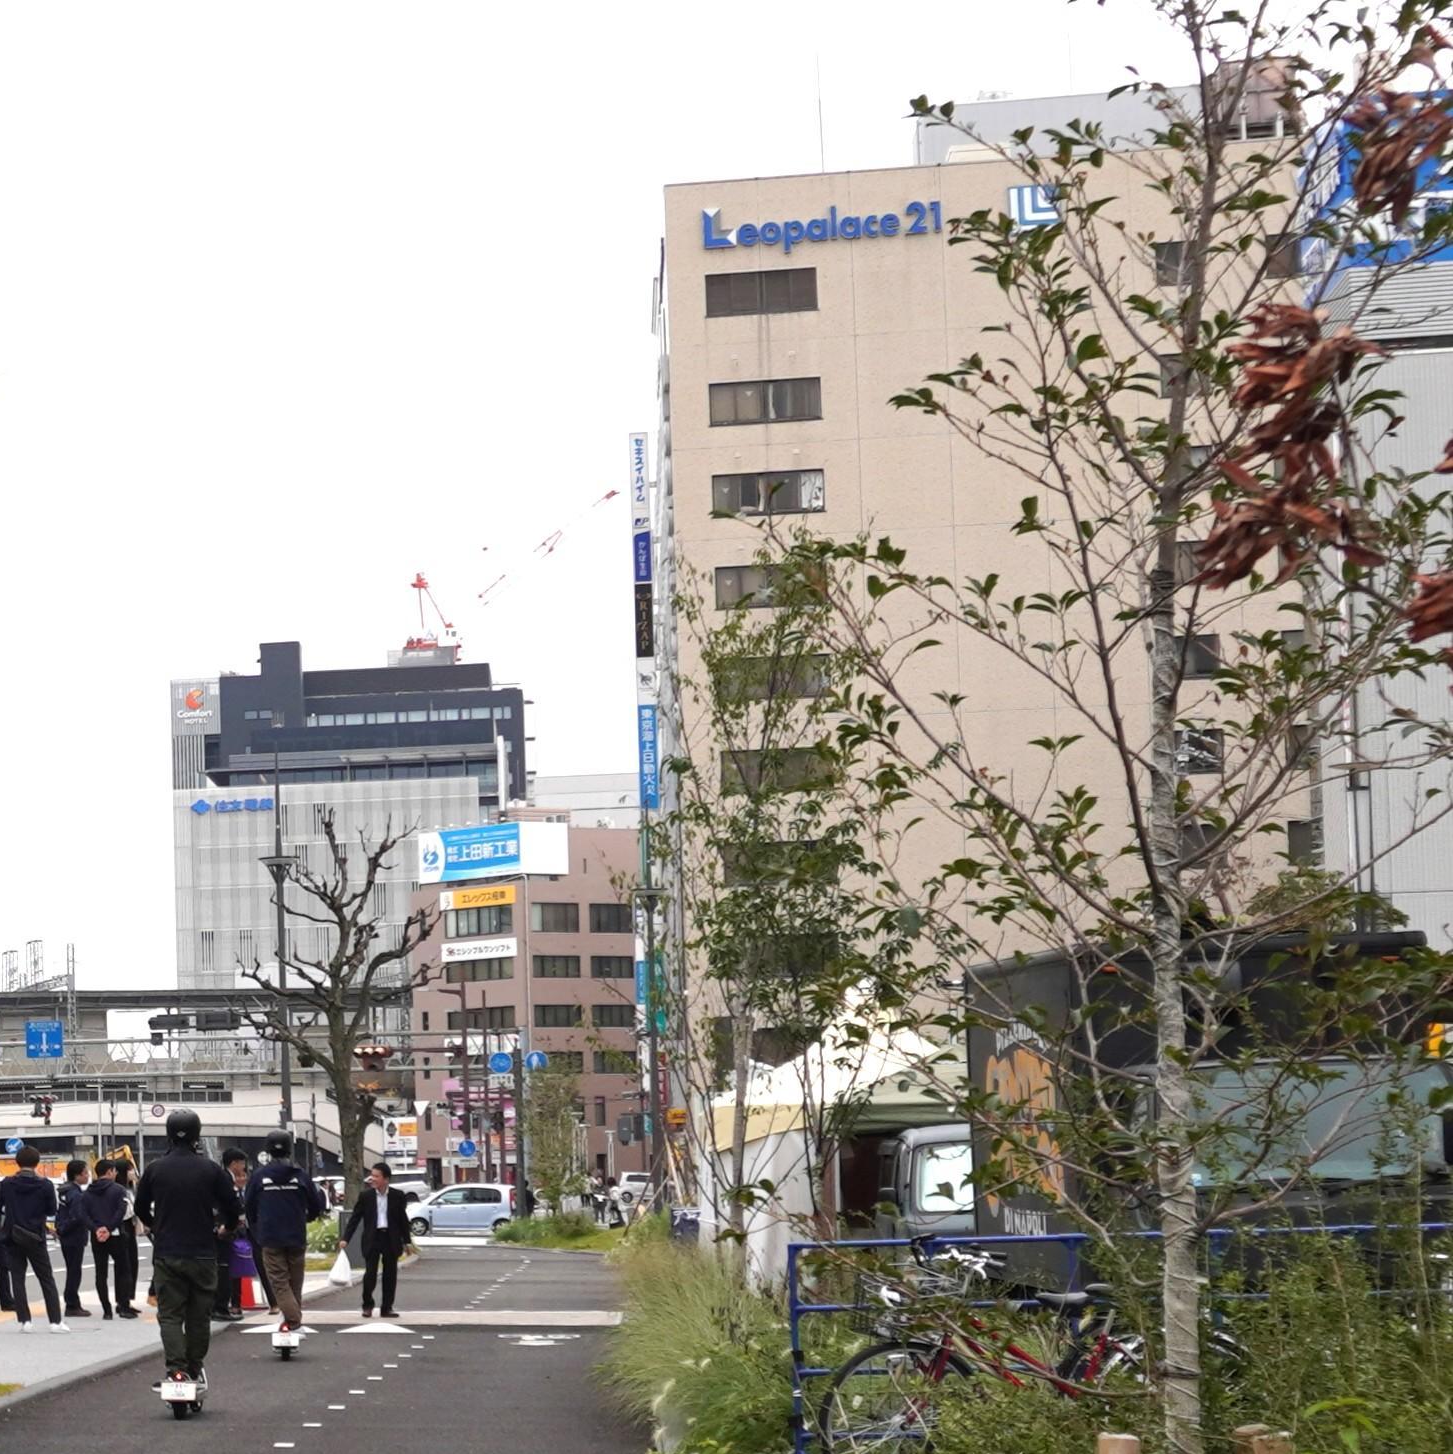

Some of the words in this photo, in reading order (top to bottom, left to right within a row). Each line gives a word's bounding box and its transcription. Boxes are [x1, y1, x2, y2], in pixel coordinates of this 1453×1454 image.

[700, 205, 902, 255] Leopalace
[904, 199, 943, 236] 21
[634, 437, 646, 503] セキスイハイム
[637, 599, 650, 653] RIZAP
[176, 709, 213, 719] Comfort
[1014, 1208, 1047, 1236] NAPOLI
